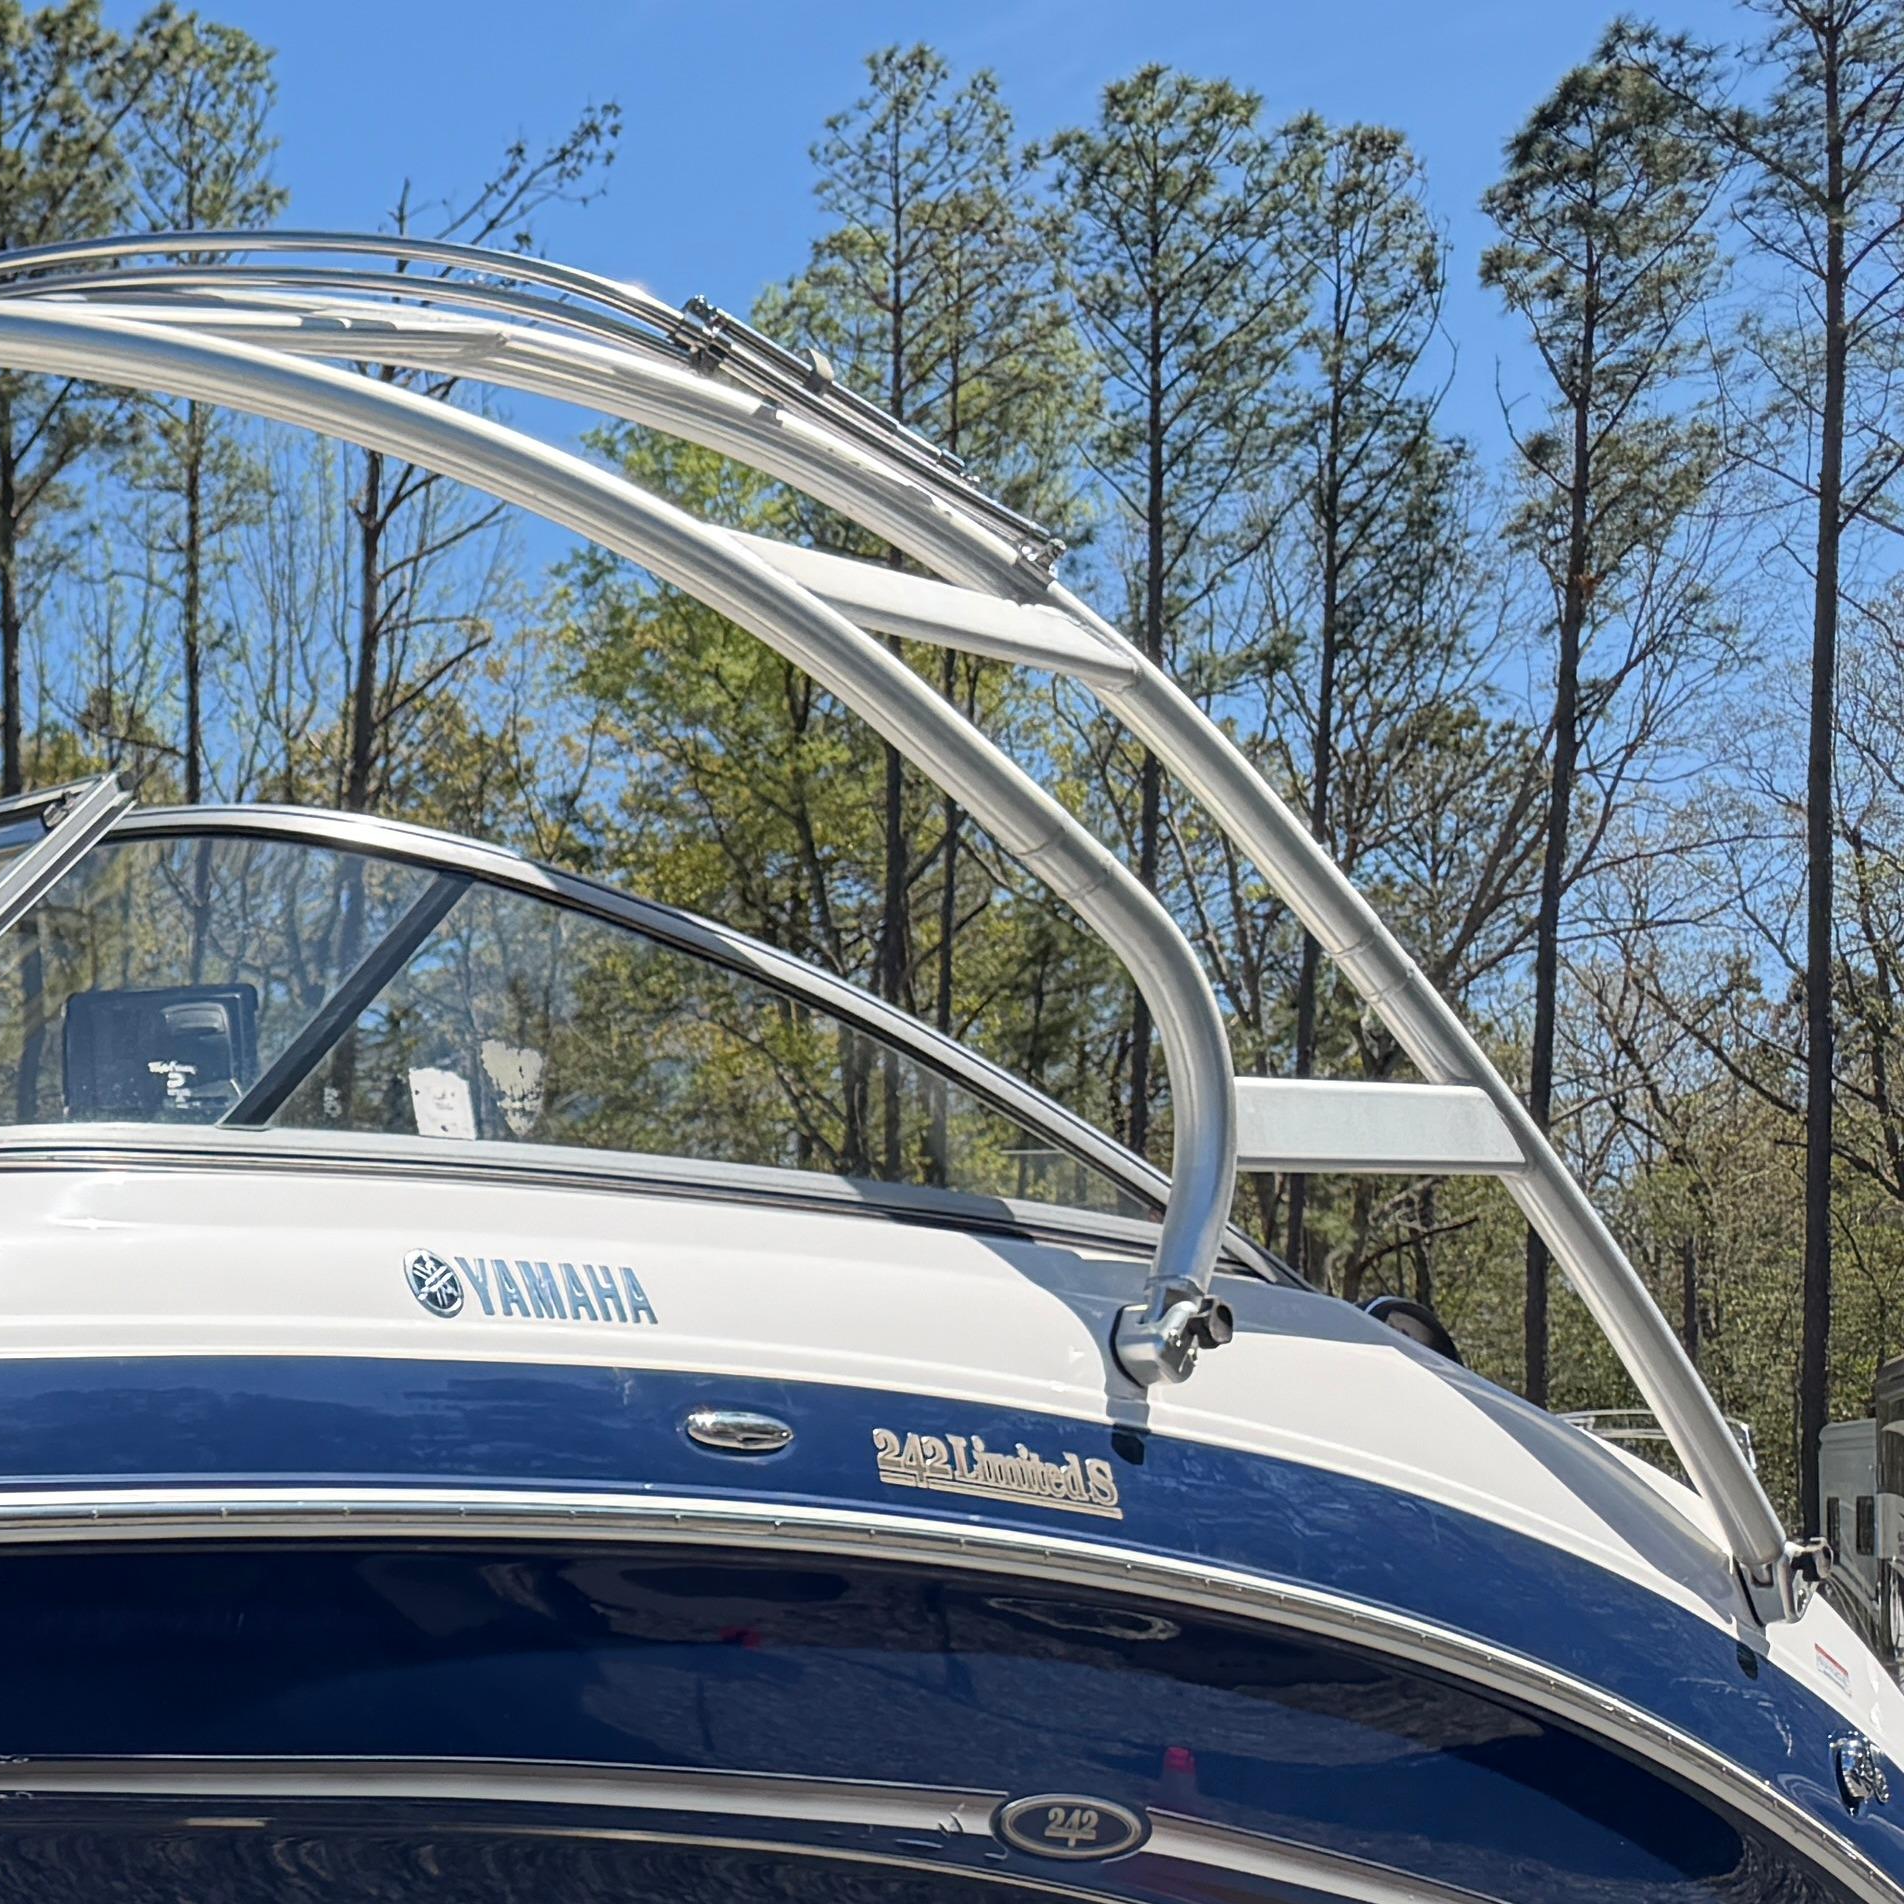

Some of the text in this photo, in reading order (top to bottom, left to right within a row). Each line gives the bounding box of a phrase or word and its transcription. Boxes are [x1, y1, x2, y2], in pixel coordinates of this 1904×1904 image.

[454, 1256, 659, 1325] YAMAHA
[872, 1427, 1119, 1507] 242 Limited S
[1044, 1807, 1099, 1848] 242
